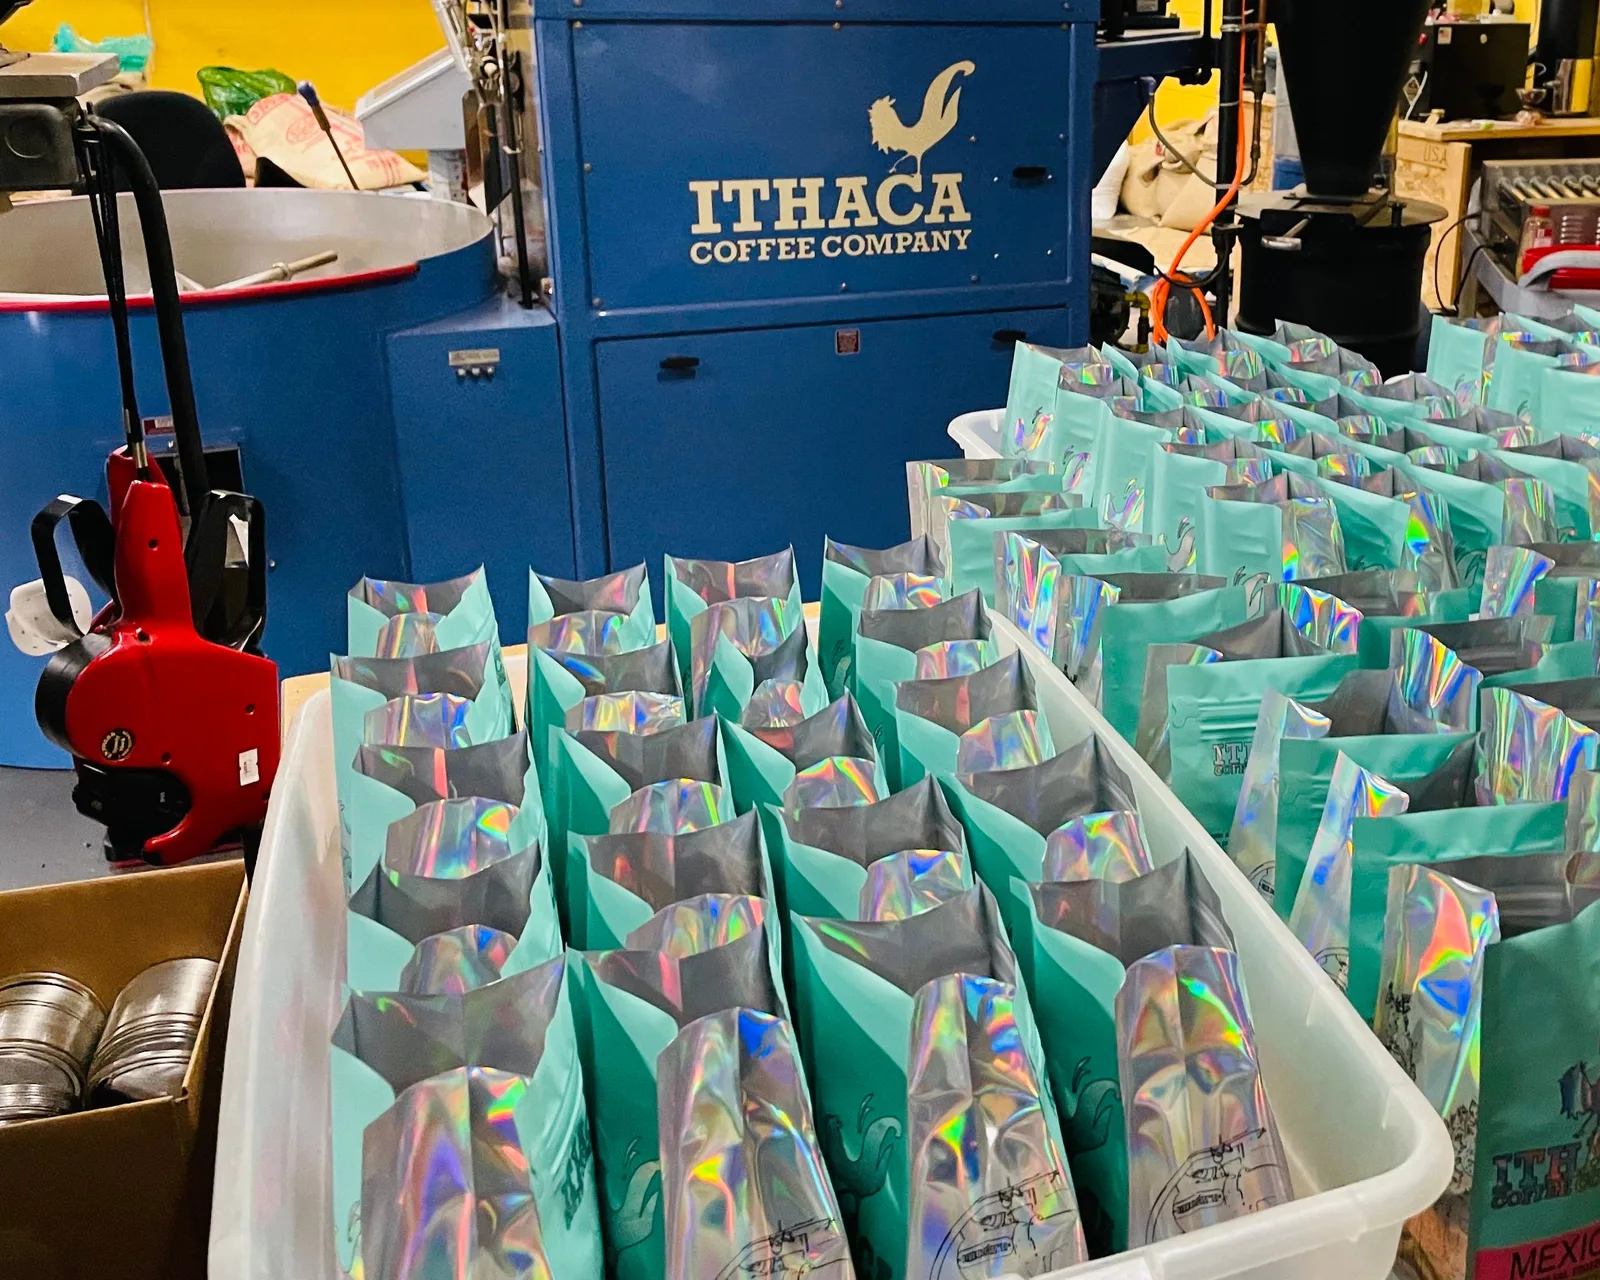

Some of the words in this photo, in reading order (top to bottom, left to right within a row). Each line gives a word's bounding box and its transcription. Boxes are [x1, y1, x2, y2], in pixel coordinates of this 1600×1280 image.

[1424, 144, 1448, 165] USA
[689, 173, 971, 234] ITHACA
[690, 236, 816, 265] COFFEE
[821, 229, 972, 257] COMPANY
